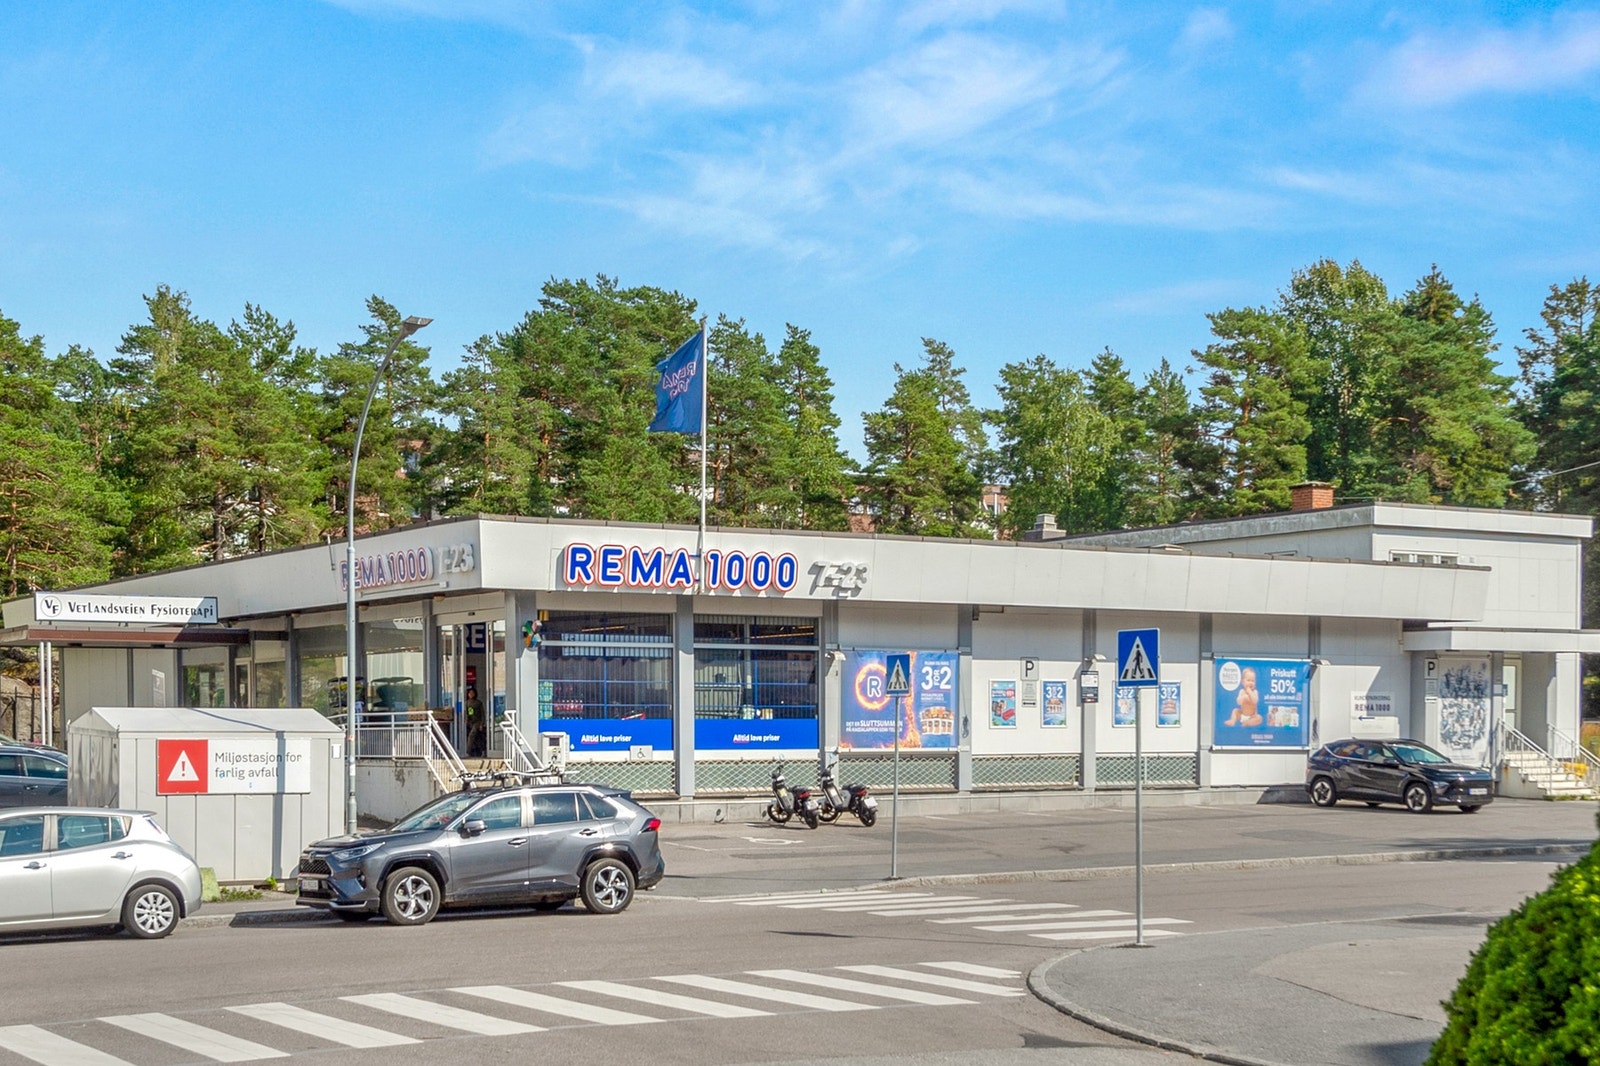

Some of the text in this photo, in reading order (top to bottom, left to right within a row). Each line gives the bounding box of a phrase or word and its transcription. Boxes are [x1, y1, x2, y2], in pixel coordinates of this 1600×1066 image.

[339, 554, 387, 592] REMA
[388, 546, 430, 585] 1000
[564, 542, 696, 588] REMA
[706, 549, 798, 593] 1000
[150, 603, 214, 619] Fysioterapi
[921, 666, 933, 690] 3
[942, 666, 952, 690] 2
[1270, 668, 1297, 678] Priskutt
[867, 676, 882, 698] R
[1046, 686, 1053, 699] 3
[1056, 686, 1064, 699] 2
[1161, 687, 1168, 699] 3
[1171, 687, 1178, 699] 2
[1270, 679, 1296, 694] 50%
[1354, 703, 1391, 711] REMA 1000
[860, 719, 903, 727] SLUTTSUMMN
[581, 734, 632, 744] Alltid lave priser
[733, 733, 781, 743] Alltid lave priser
[215, 752, 302, 766] Miljøstasjon for
[215, 767, 279, 780] farlig avfall
